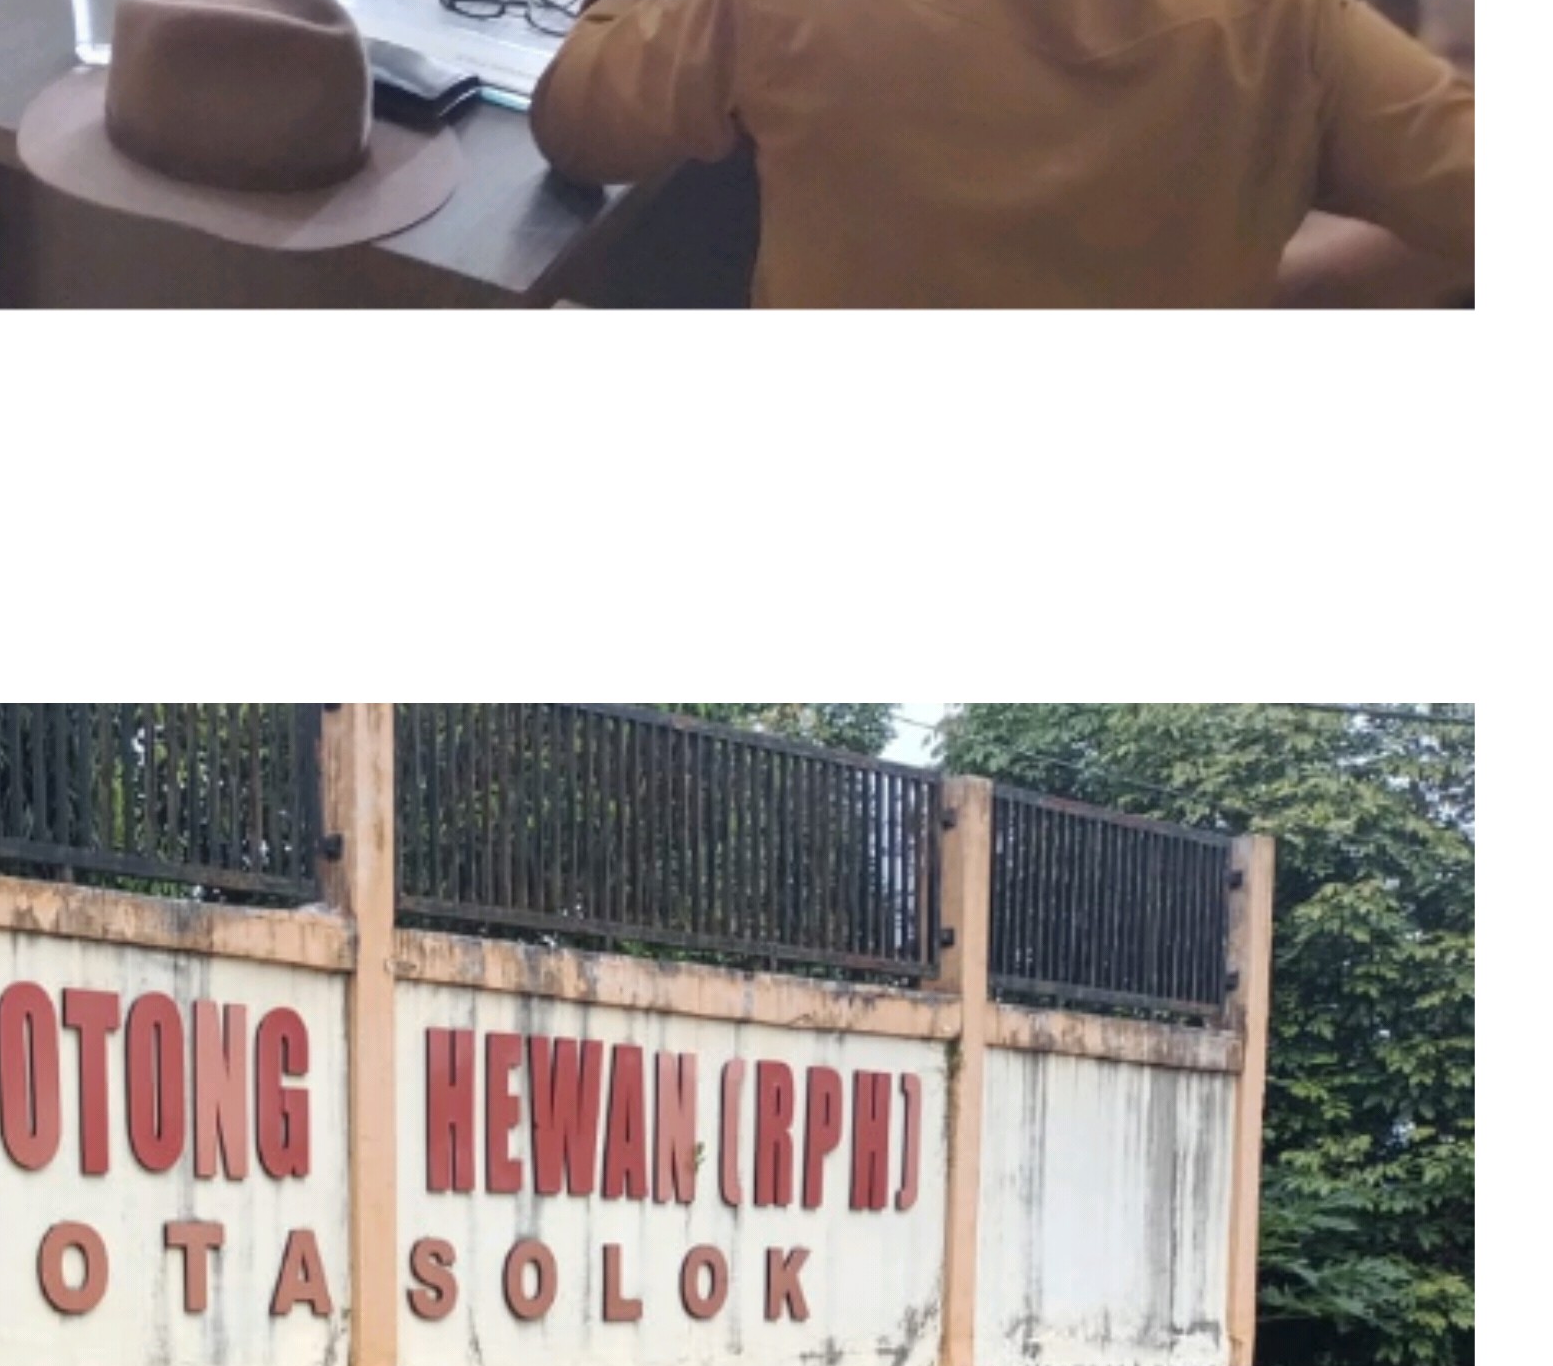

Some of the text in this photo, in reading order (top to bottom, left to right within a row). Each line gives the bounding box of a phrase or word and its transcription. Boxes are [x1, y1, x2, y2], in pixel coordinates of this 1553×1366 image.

[424, 1025, 700, 1206] HEWAN
[718, 1056, 924, 1213] (RPH)
[406, 1235, 811, 1323] SOLOK
